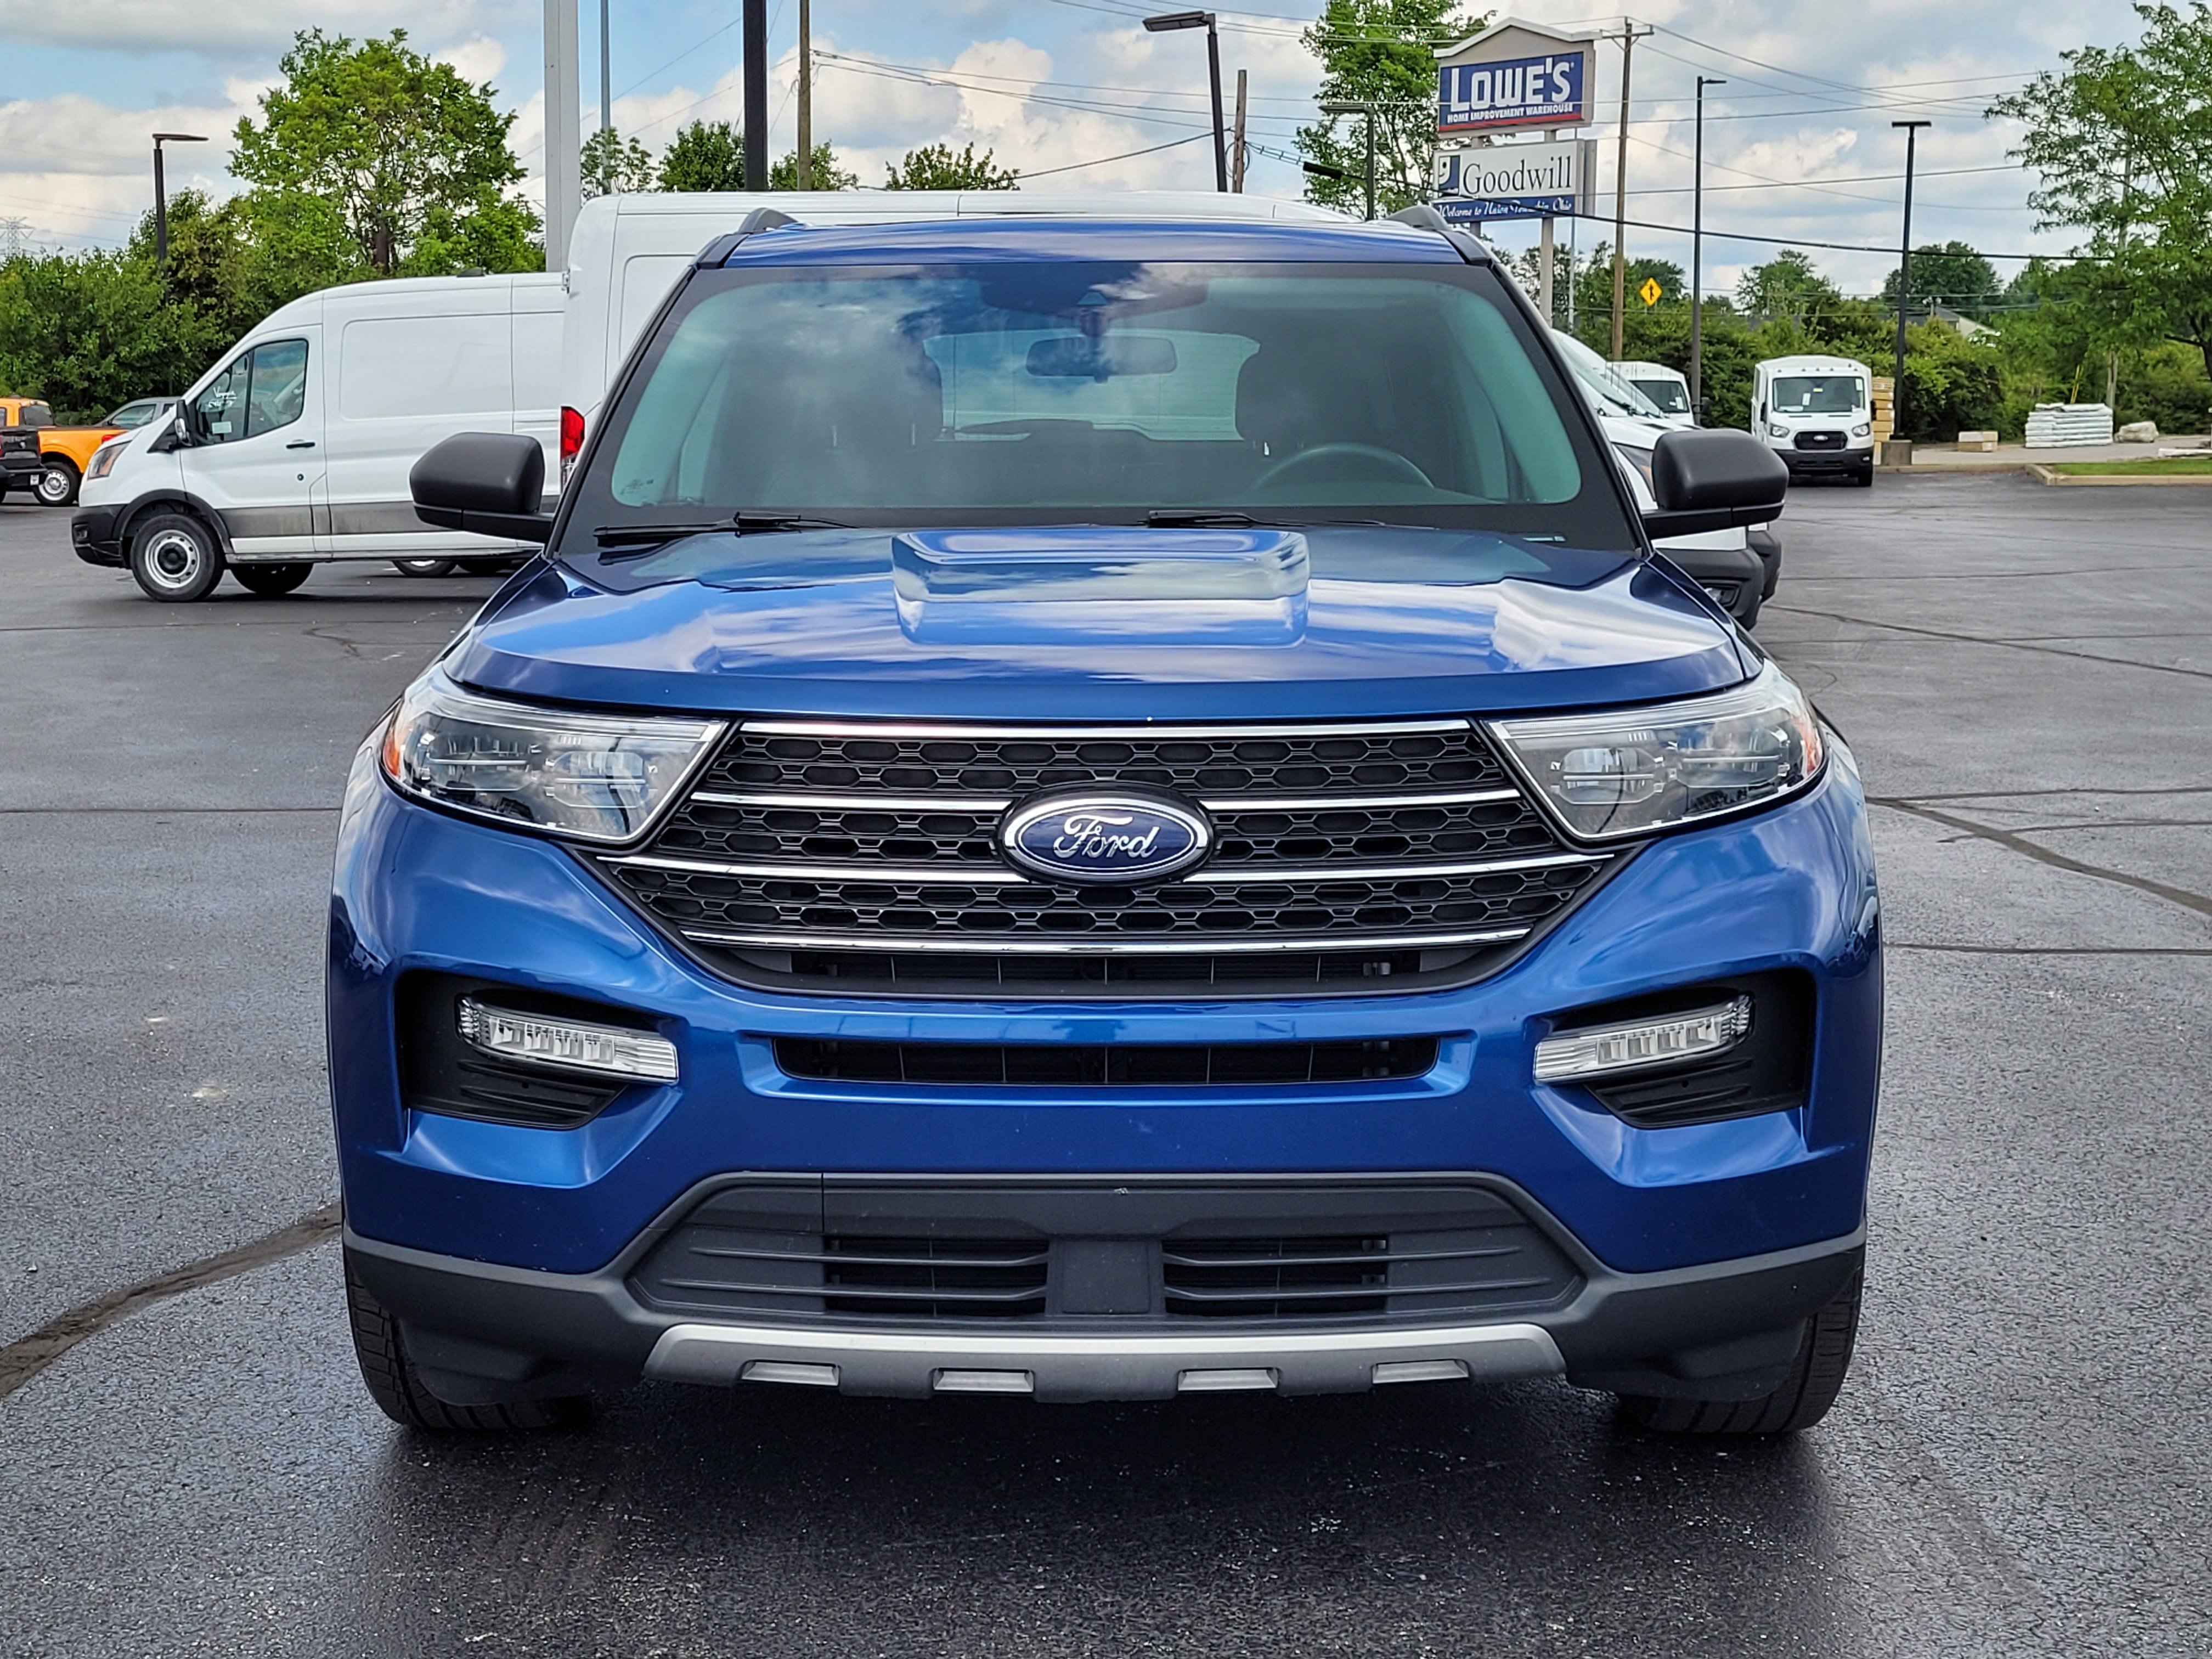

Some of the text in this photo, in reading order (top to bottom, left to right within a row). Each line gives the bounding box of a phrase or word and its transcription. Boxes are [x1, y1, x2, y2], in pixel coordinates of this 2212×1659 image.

[1451, 57, 1572, 112] LOWE'S
[1447, 102, 1573, 124] HOME IMPROVEMENT WAREHOUSE
[1463, 156, 1571, 195] Goodwill
[1438, 204, 1472, 217] Welcome
[1474, 206, 1482, 216] to
[1553, 197, 1572, 211] Ohio
[1053, 815, 1160, 857] Ford
